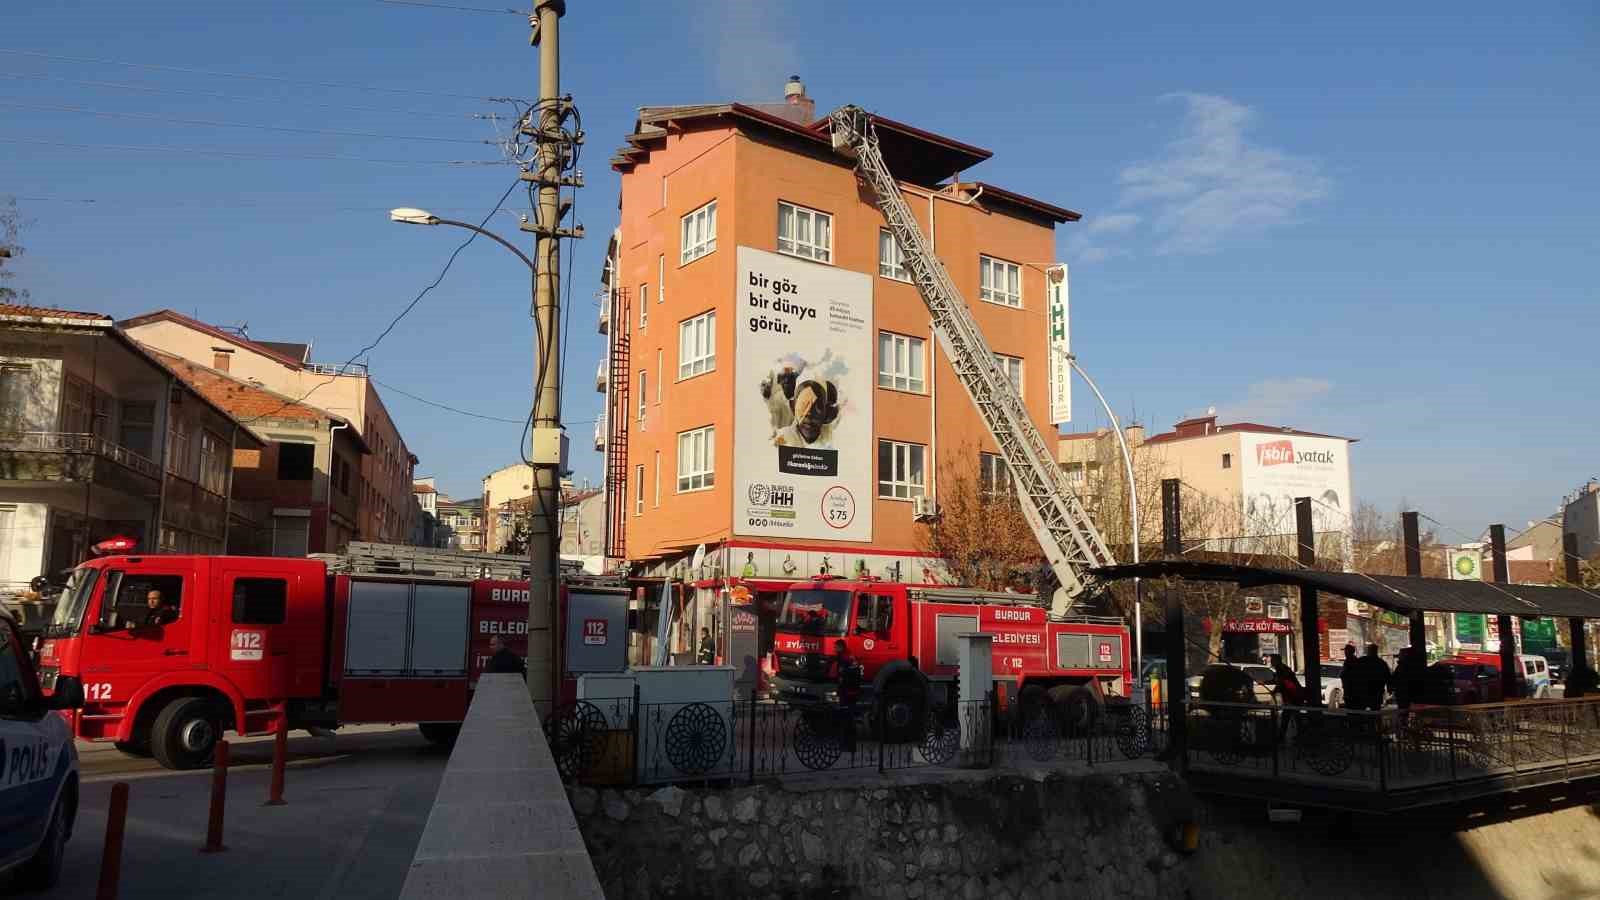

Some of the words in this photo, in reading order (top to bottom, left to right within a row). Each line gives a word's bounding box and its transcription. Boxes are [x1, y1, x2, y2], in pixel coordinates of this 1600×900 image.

[749, 271, 768, 288] bir
[772, 279, 798, 295] göz
[749, 292, 769, 308] bir
[772, 298, 816, 320] dünya
[749, 315, 790, 334] görür.
[1296, 450, 1335, 465] yatak
[492, 588, 529, 602] BURD
[995, 609, 1031, 621] BURDUR
[586, 622, 604, 634] 112
[236, 632, 260, 648] 112
[992, 631, 1040, 643] ELEDİYESİ
[1012, 657, 1023, 668] 112
[83, 683, 112, 700] 112
